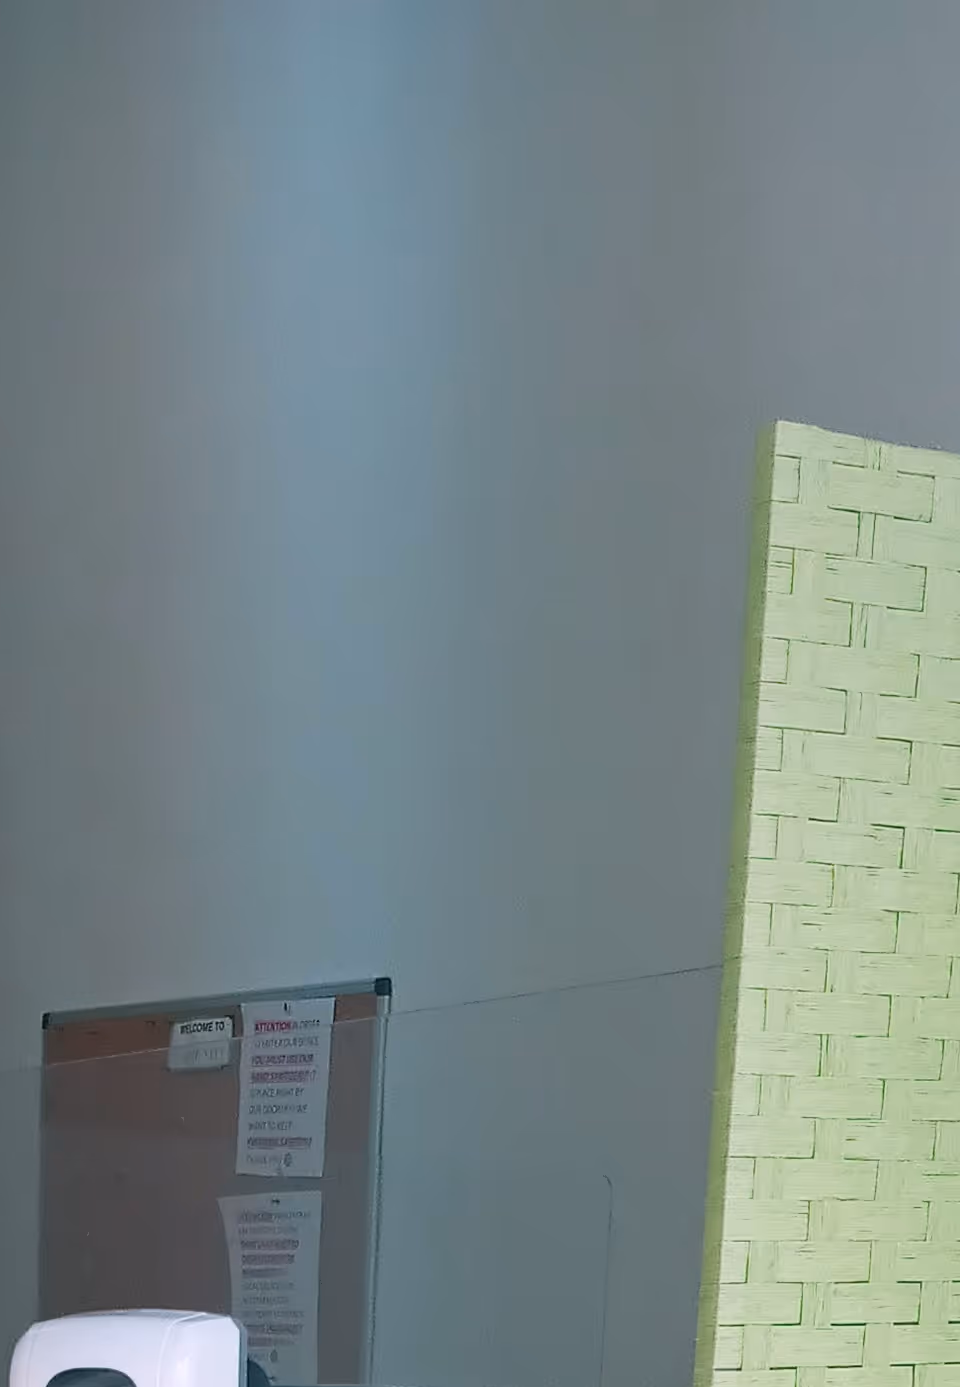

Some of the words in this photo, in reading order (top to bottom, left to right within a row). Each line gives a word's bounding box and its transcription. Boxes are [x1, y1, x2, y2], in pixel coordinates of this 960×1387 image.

[180, 1021, 214, 1035] WELCOME
[215, 1020, 225, 1031] TO
[255, 1021, 291, 1033] ATTENTION
